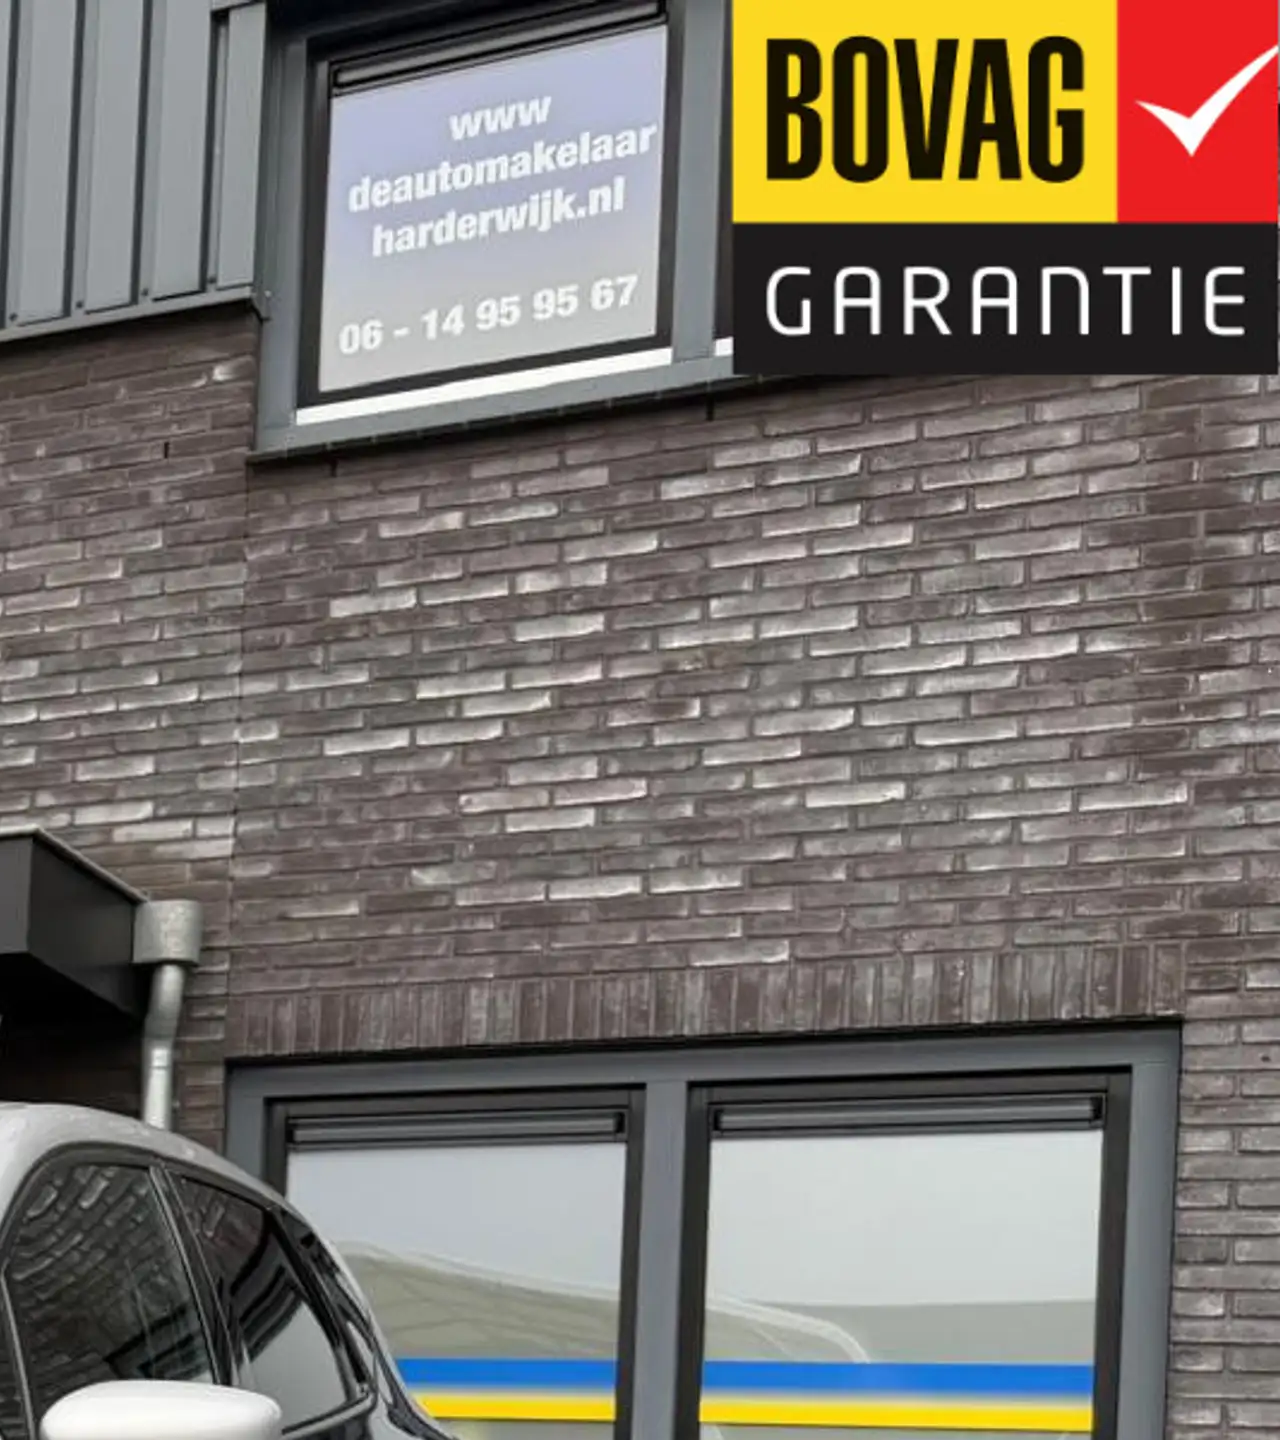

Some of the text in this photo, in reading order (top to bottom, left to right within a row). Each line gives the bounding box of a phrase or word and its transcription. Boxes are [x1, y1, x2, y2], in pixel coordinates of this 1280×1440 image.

[449, 94, 552, 140] www
[349, 122, 657, 212] deautomakelaar
[372, 177, 626, 257] harderwijk.nl
[340, 314, 383, 356] 06
[420, 298, 465, 342] 14
[475, 291, 521, 334] 95
[532, 283, 580, 326] 95
[590, 273, 639, 316] 67
